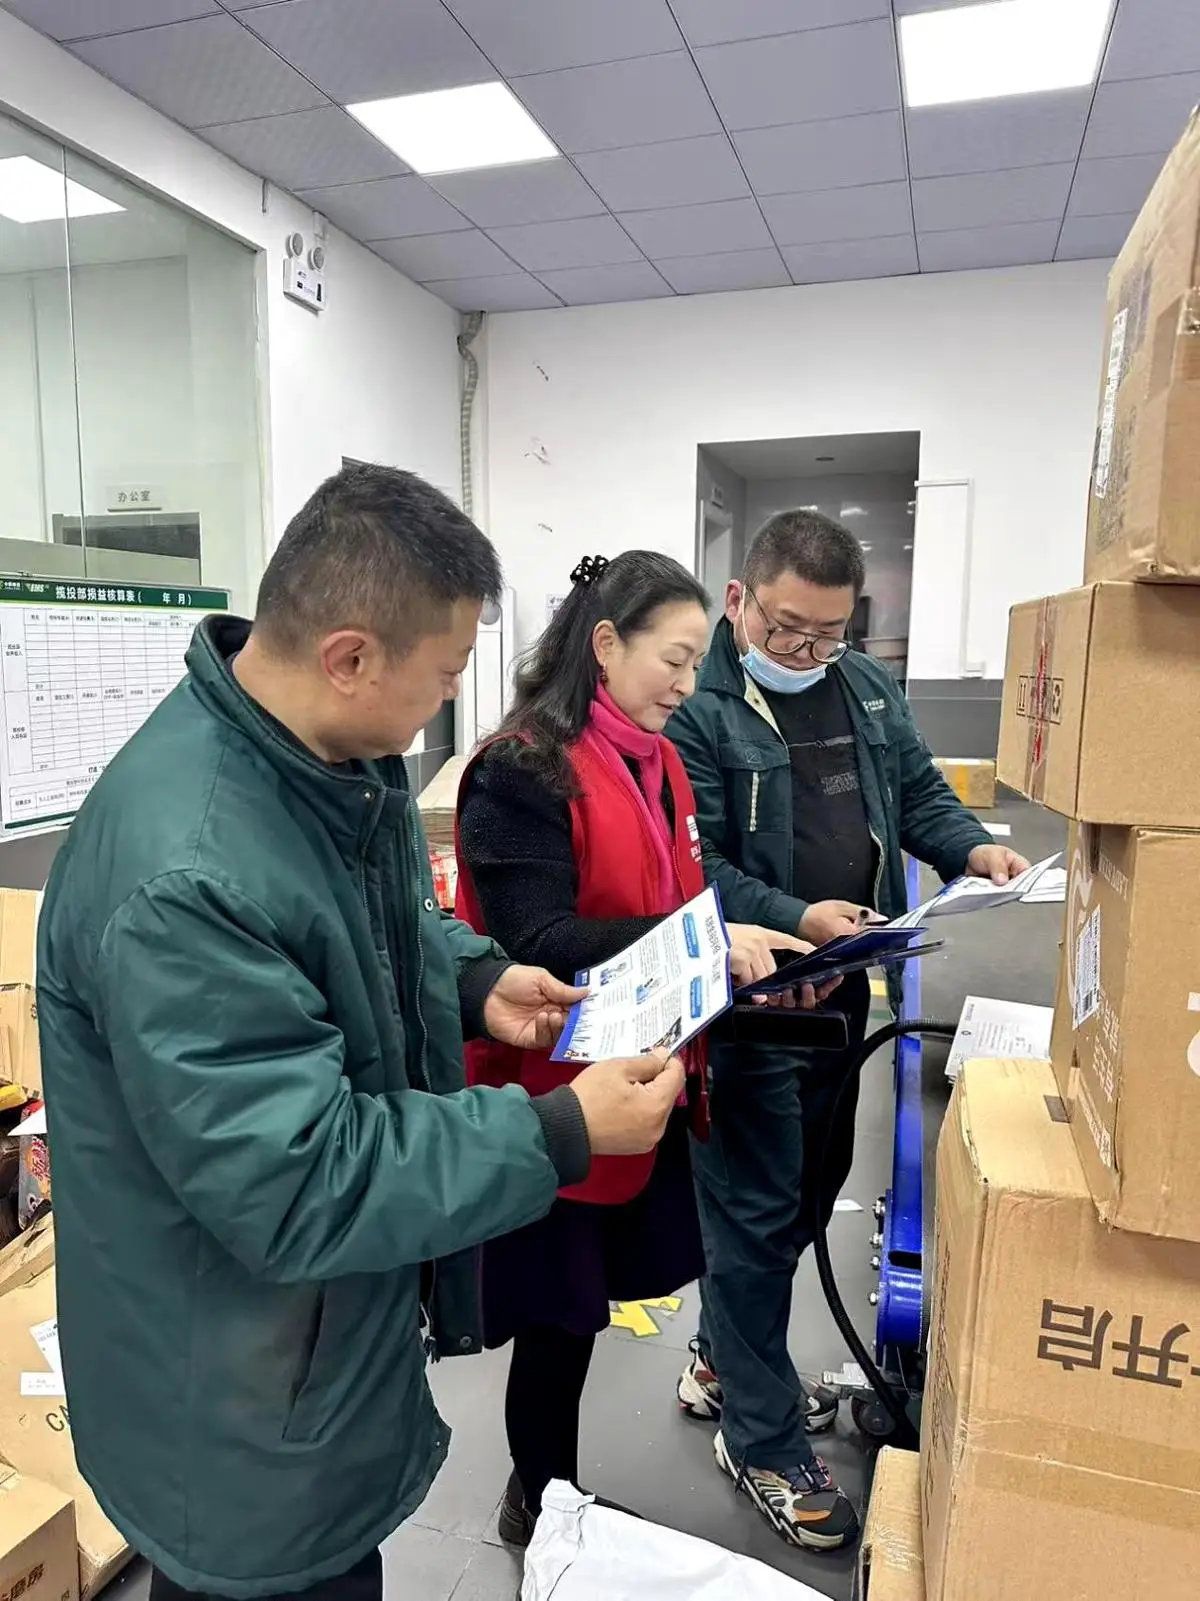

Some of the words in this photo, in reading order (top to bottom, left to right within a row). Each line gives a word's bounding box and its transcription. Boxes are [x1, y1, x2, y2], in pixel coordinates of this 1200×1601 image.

[118, 490, 150, 502] 办公室
[162, 592, 171, 604] 年
[1037, 1299, 1200, 1388] 开启
